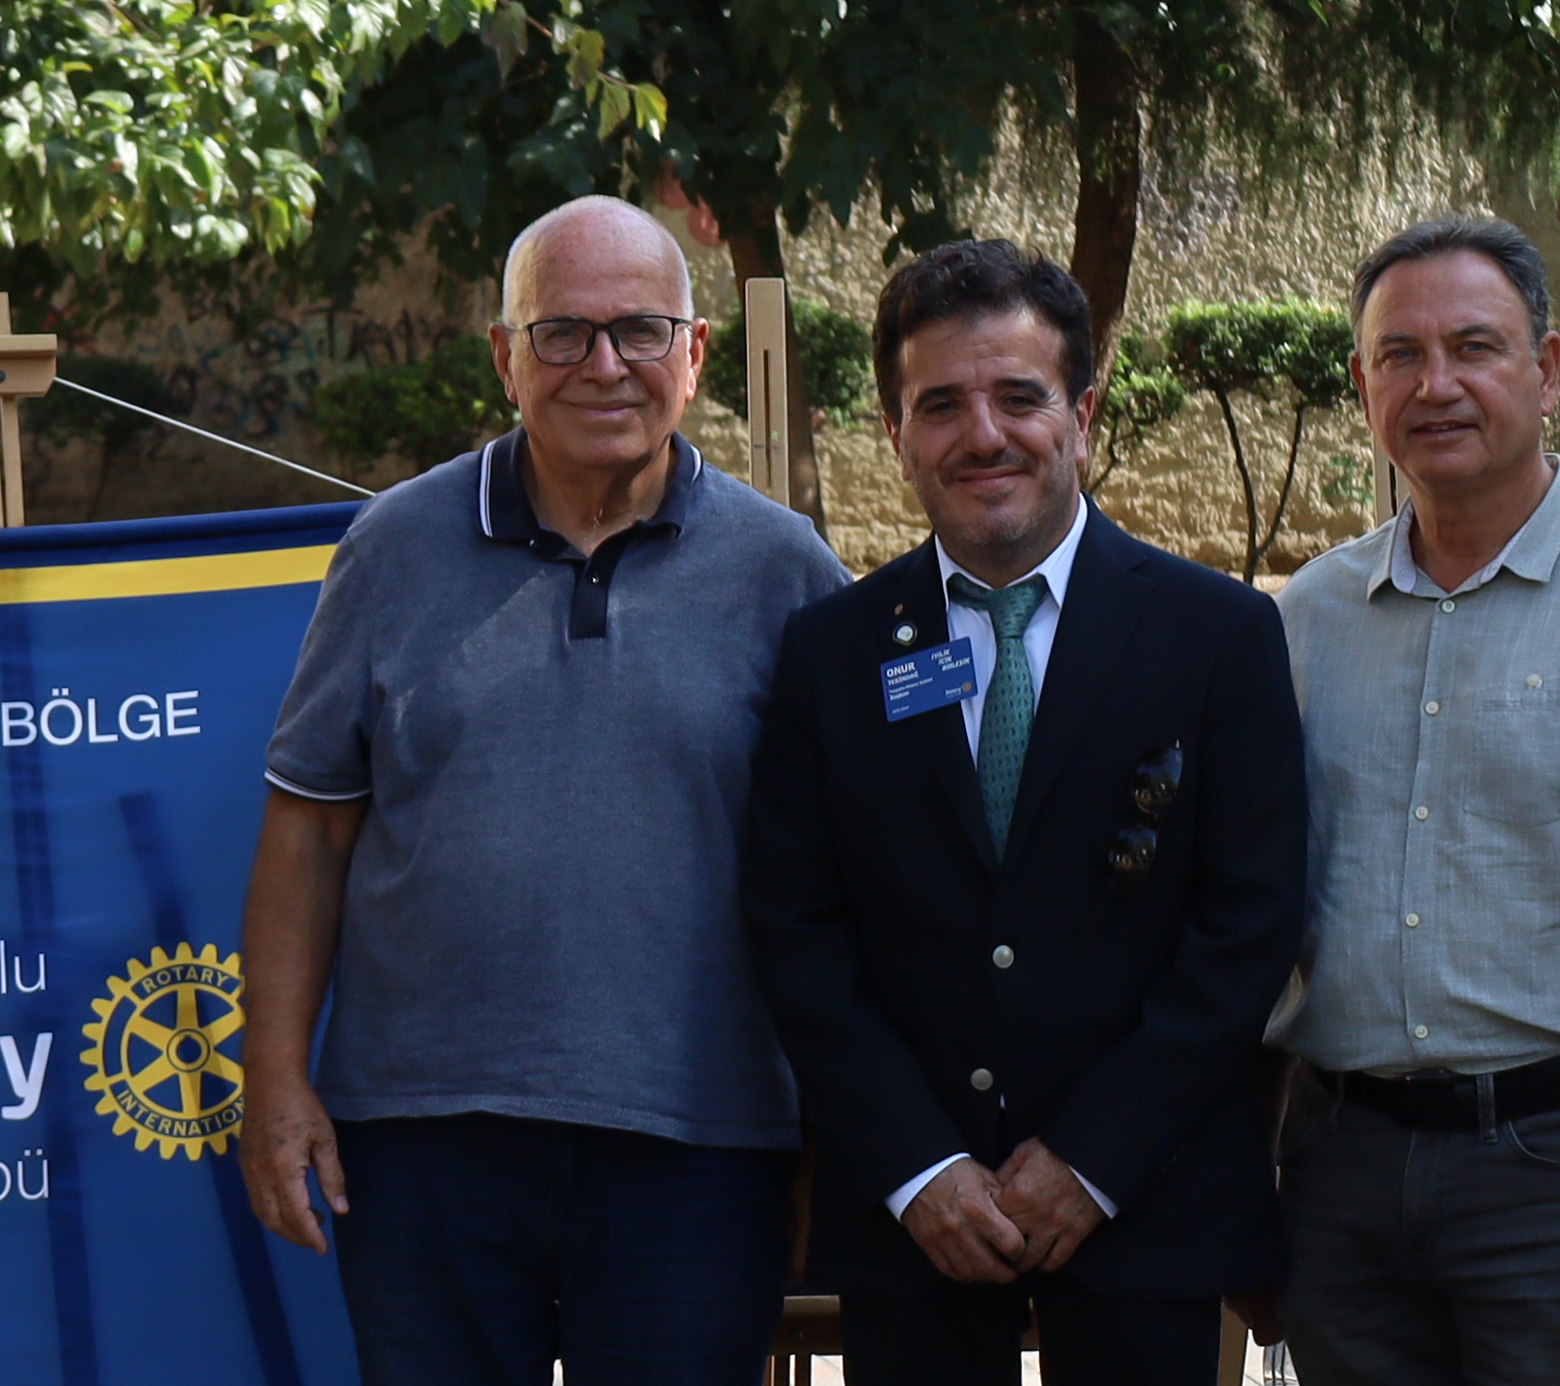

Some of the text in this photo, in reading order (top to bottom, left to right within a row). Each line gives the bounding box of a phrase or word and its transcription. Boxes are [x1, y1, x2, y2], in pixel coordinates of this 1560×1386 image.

[886, 661, 916, 678] ONUR
[1, 688, 201, 746] BÖLGE
[141, 966, 230, 994] ROTARY
